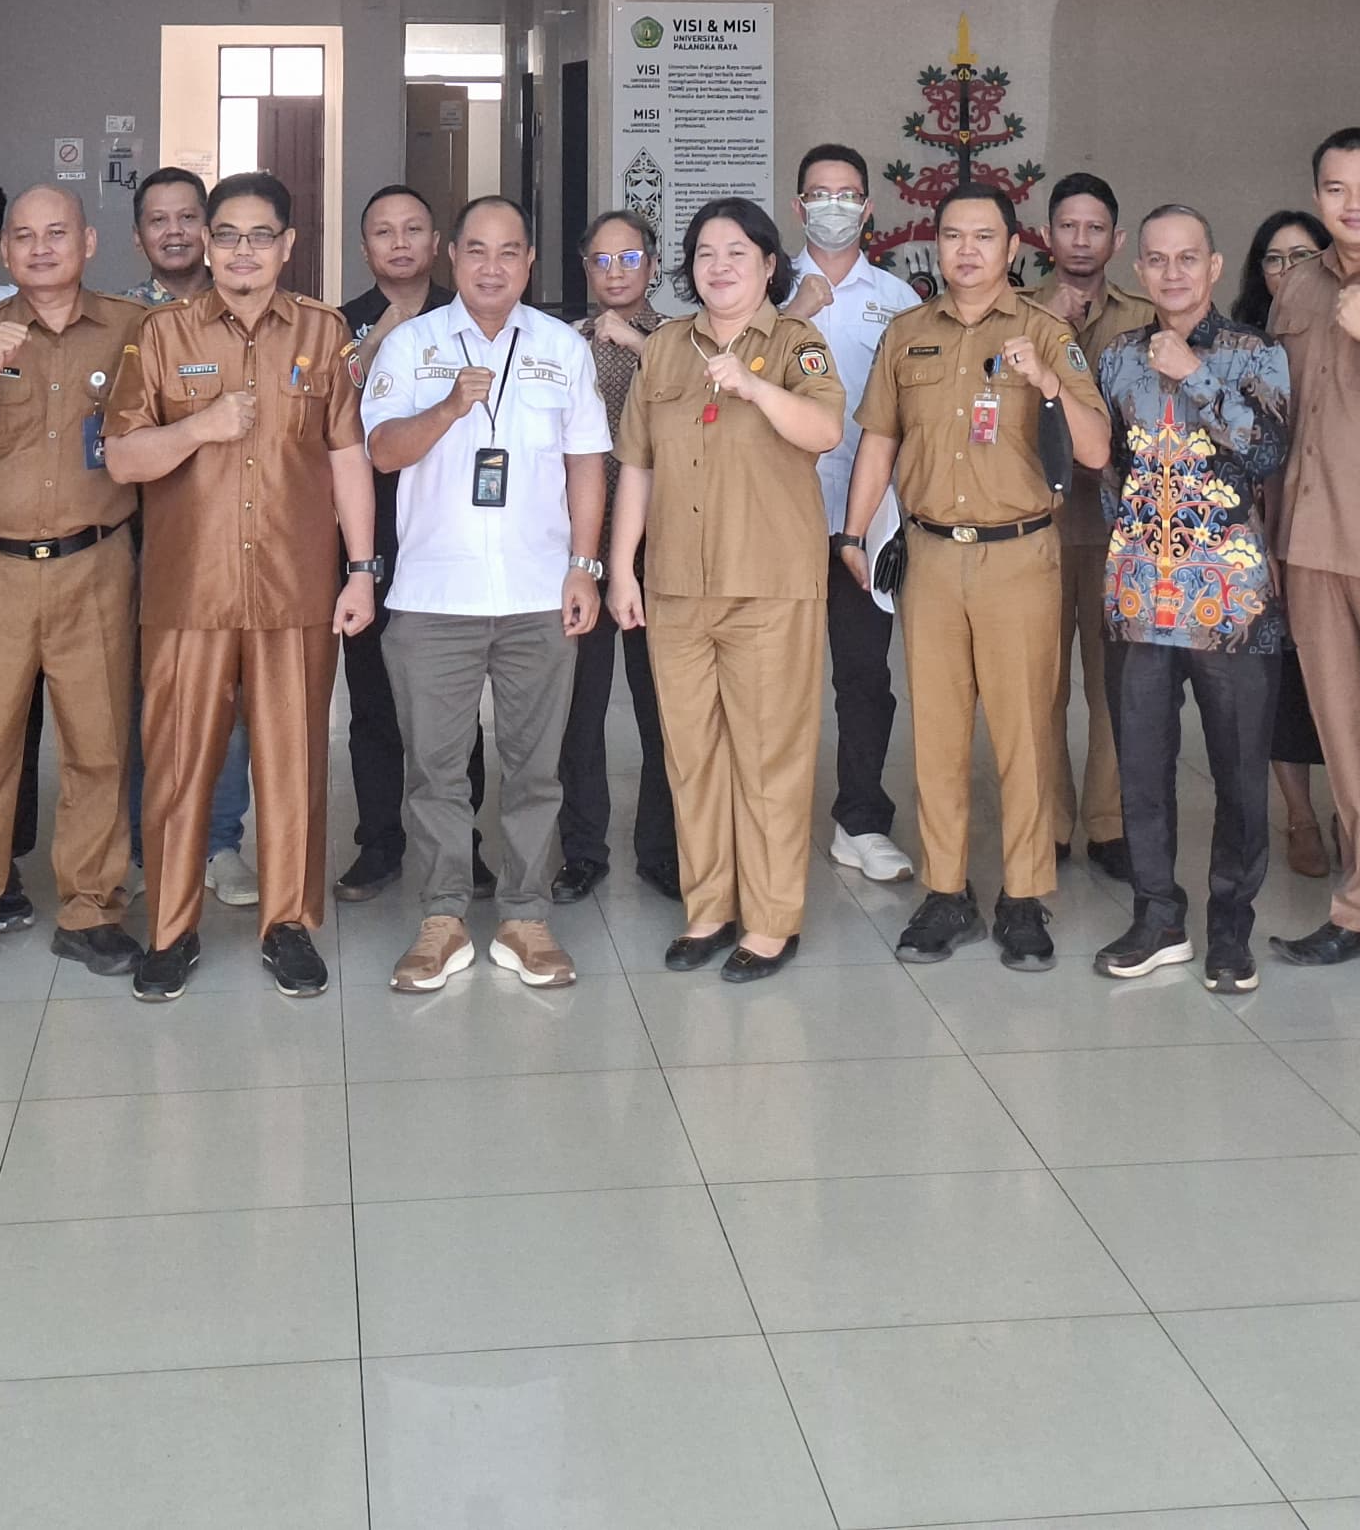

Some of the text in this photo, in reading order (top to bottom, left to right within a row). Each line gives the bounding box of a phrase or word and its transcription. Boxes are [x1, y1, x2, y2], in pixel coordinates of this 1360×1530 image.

[673, 19, 756, 33] VISI & MISI
[717, 43, 738, 51] RAYA
[636, 64, 660, 75] VISI
[634, 109, 660, 120] MISI
[534, 370, 555, 381] UPR
